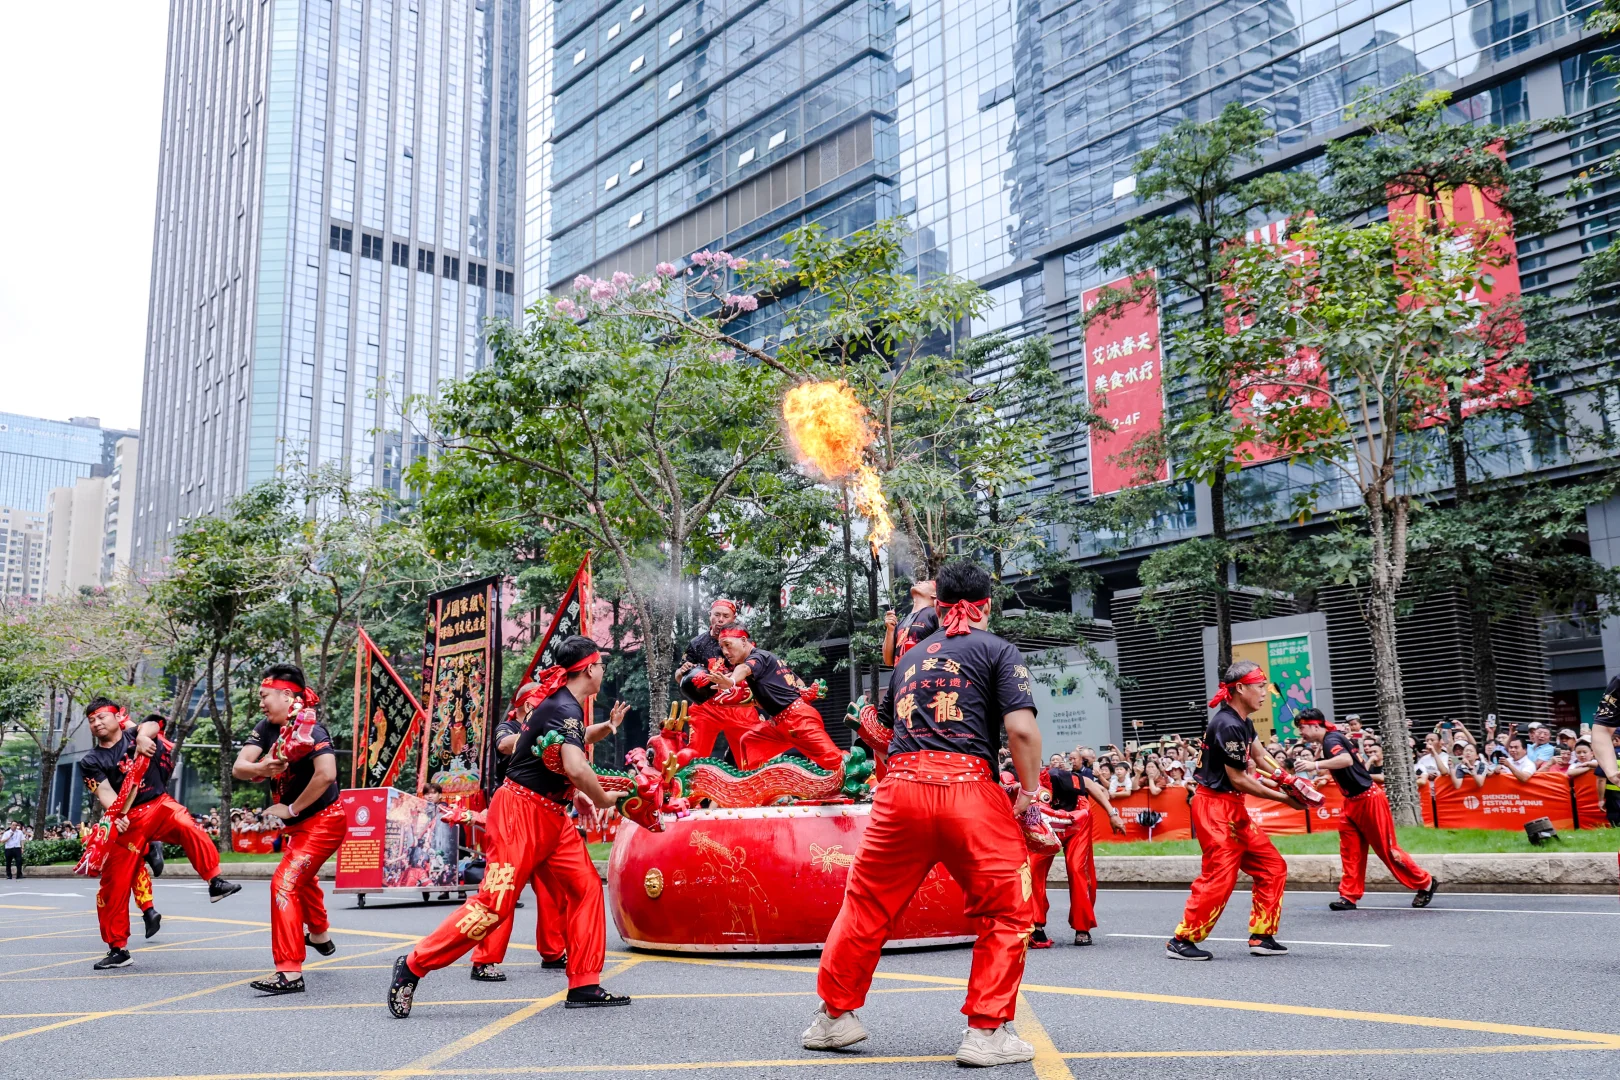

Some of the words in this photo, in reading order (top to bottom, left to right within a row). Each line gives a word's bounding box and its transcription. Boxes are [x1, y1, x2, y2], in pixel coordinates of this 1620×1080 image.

[1092, 332, 1153, 366] 艾沐春天
[1094, 360, 1154, 394] 美食水疗
[1112, 411, 1140, 430] 2-4F
[904, 657, 961, 683] 国家级
